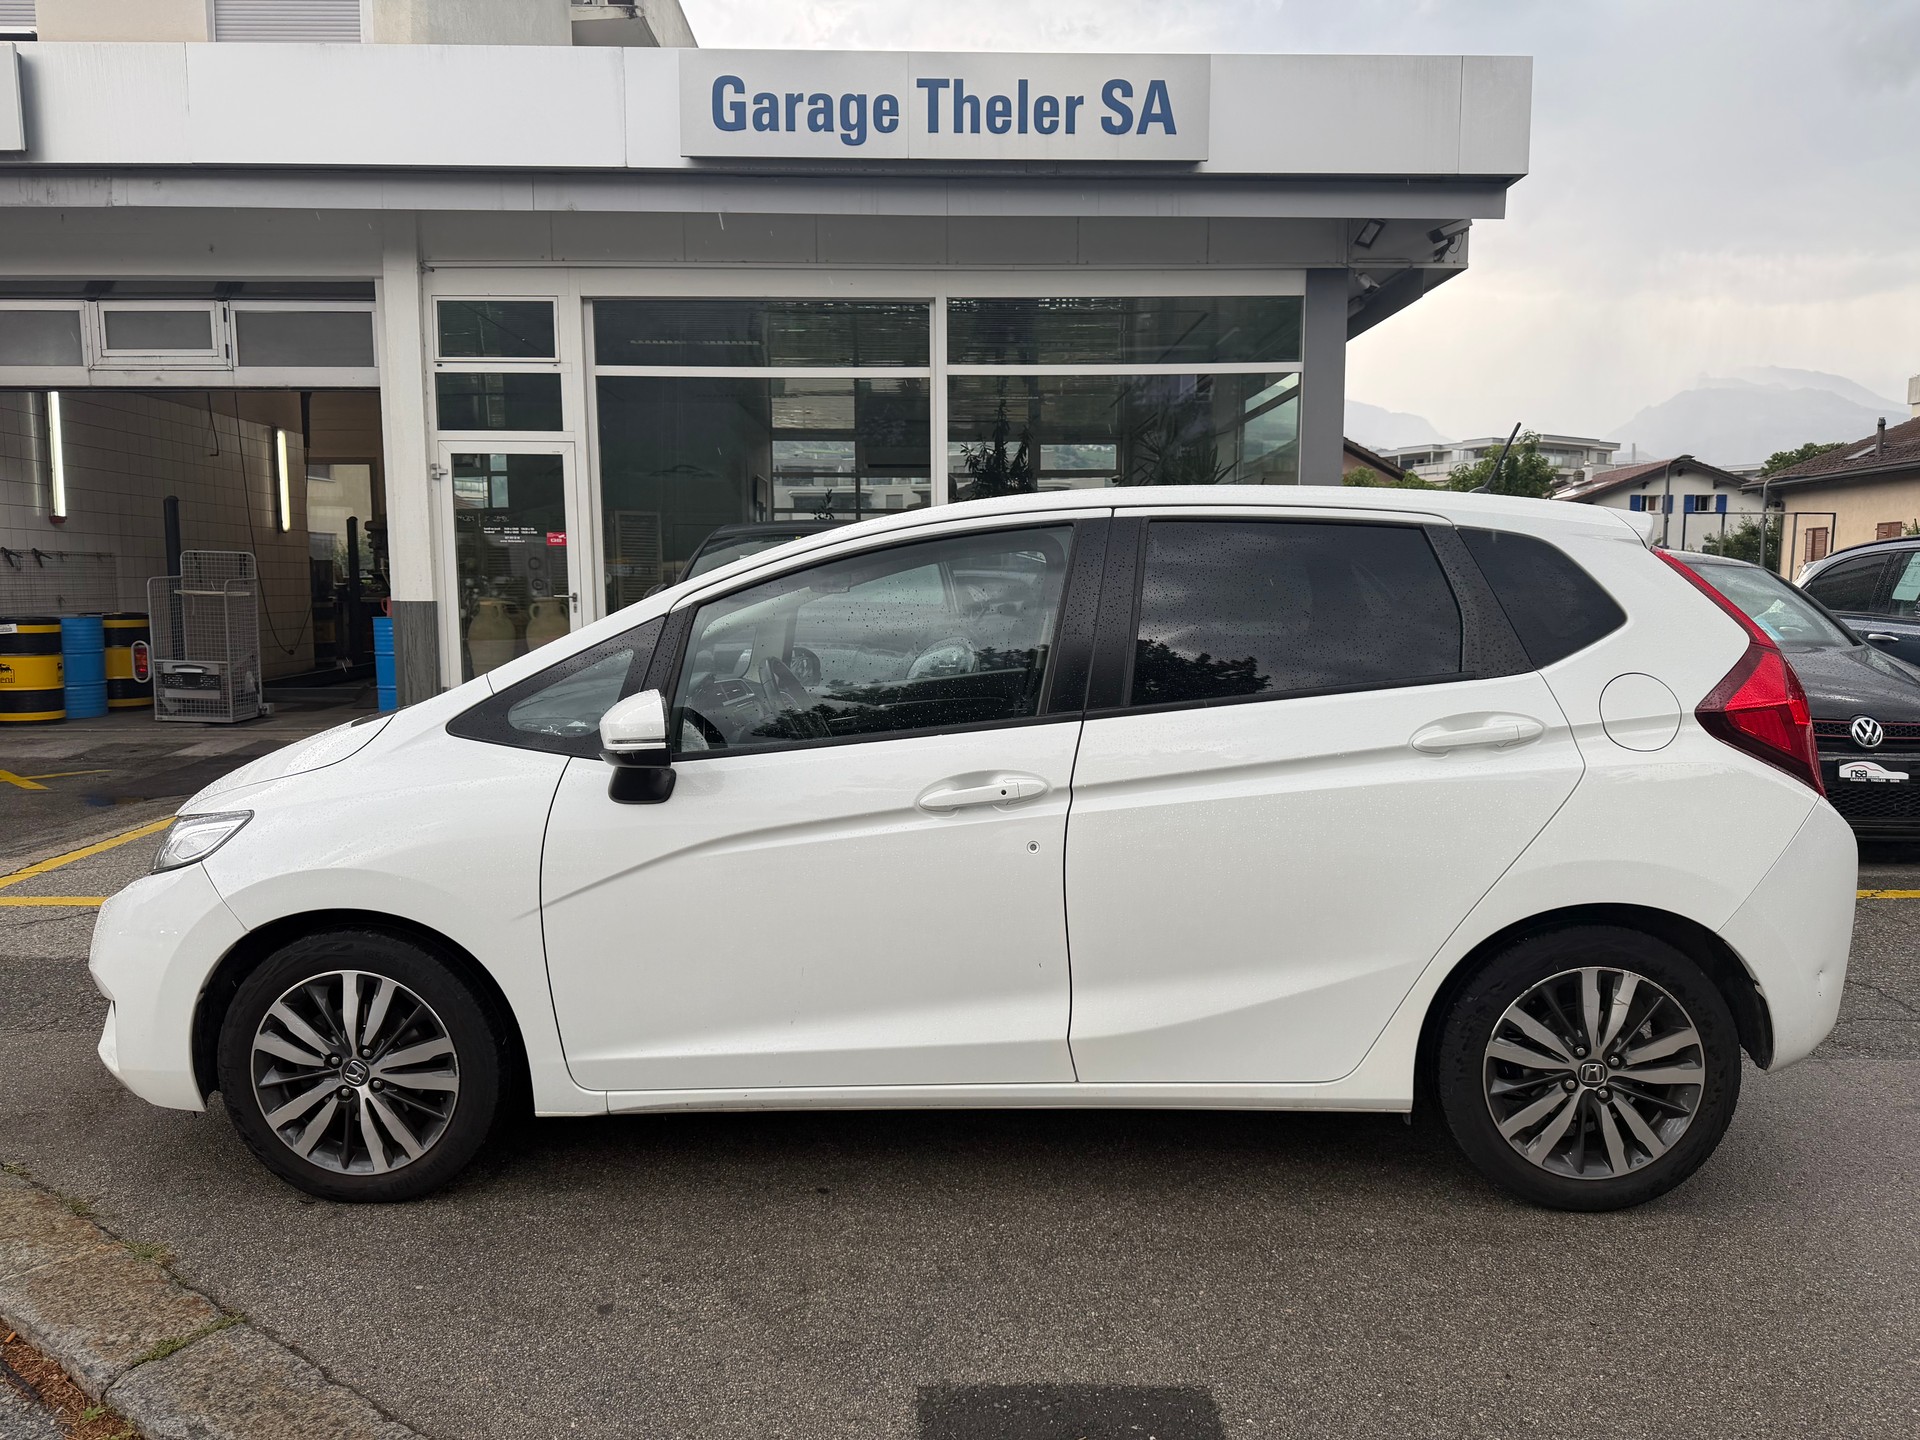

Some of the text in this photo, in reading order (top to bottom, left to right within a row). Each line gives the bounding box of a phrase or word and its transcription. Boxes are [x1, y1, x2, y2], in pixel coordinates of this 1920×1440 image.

[711, 75, 1178, 147] Garage Theler SA
[1850, 769, 1868, 778] nsa
